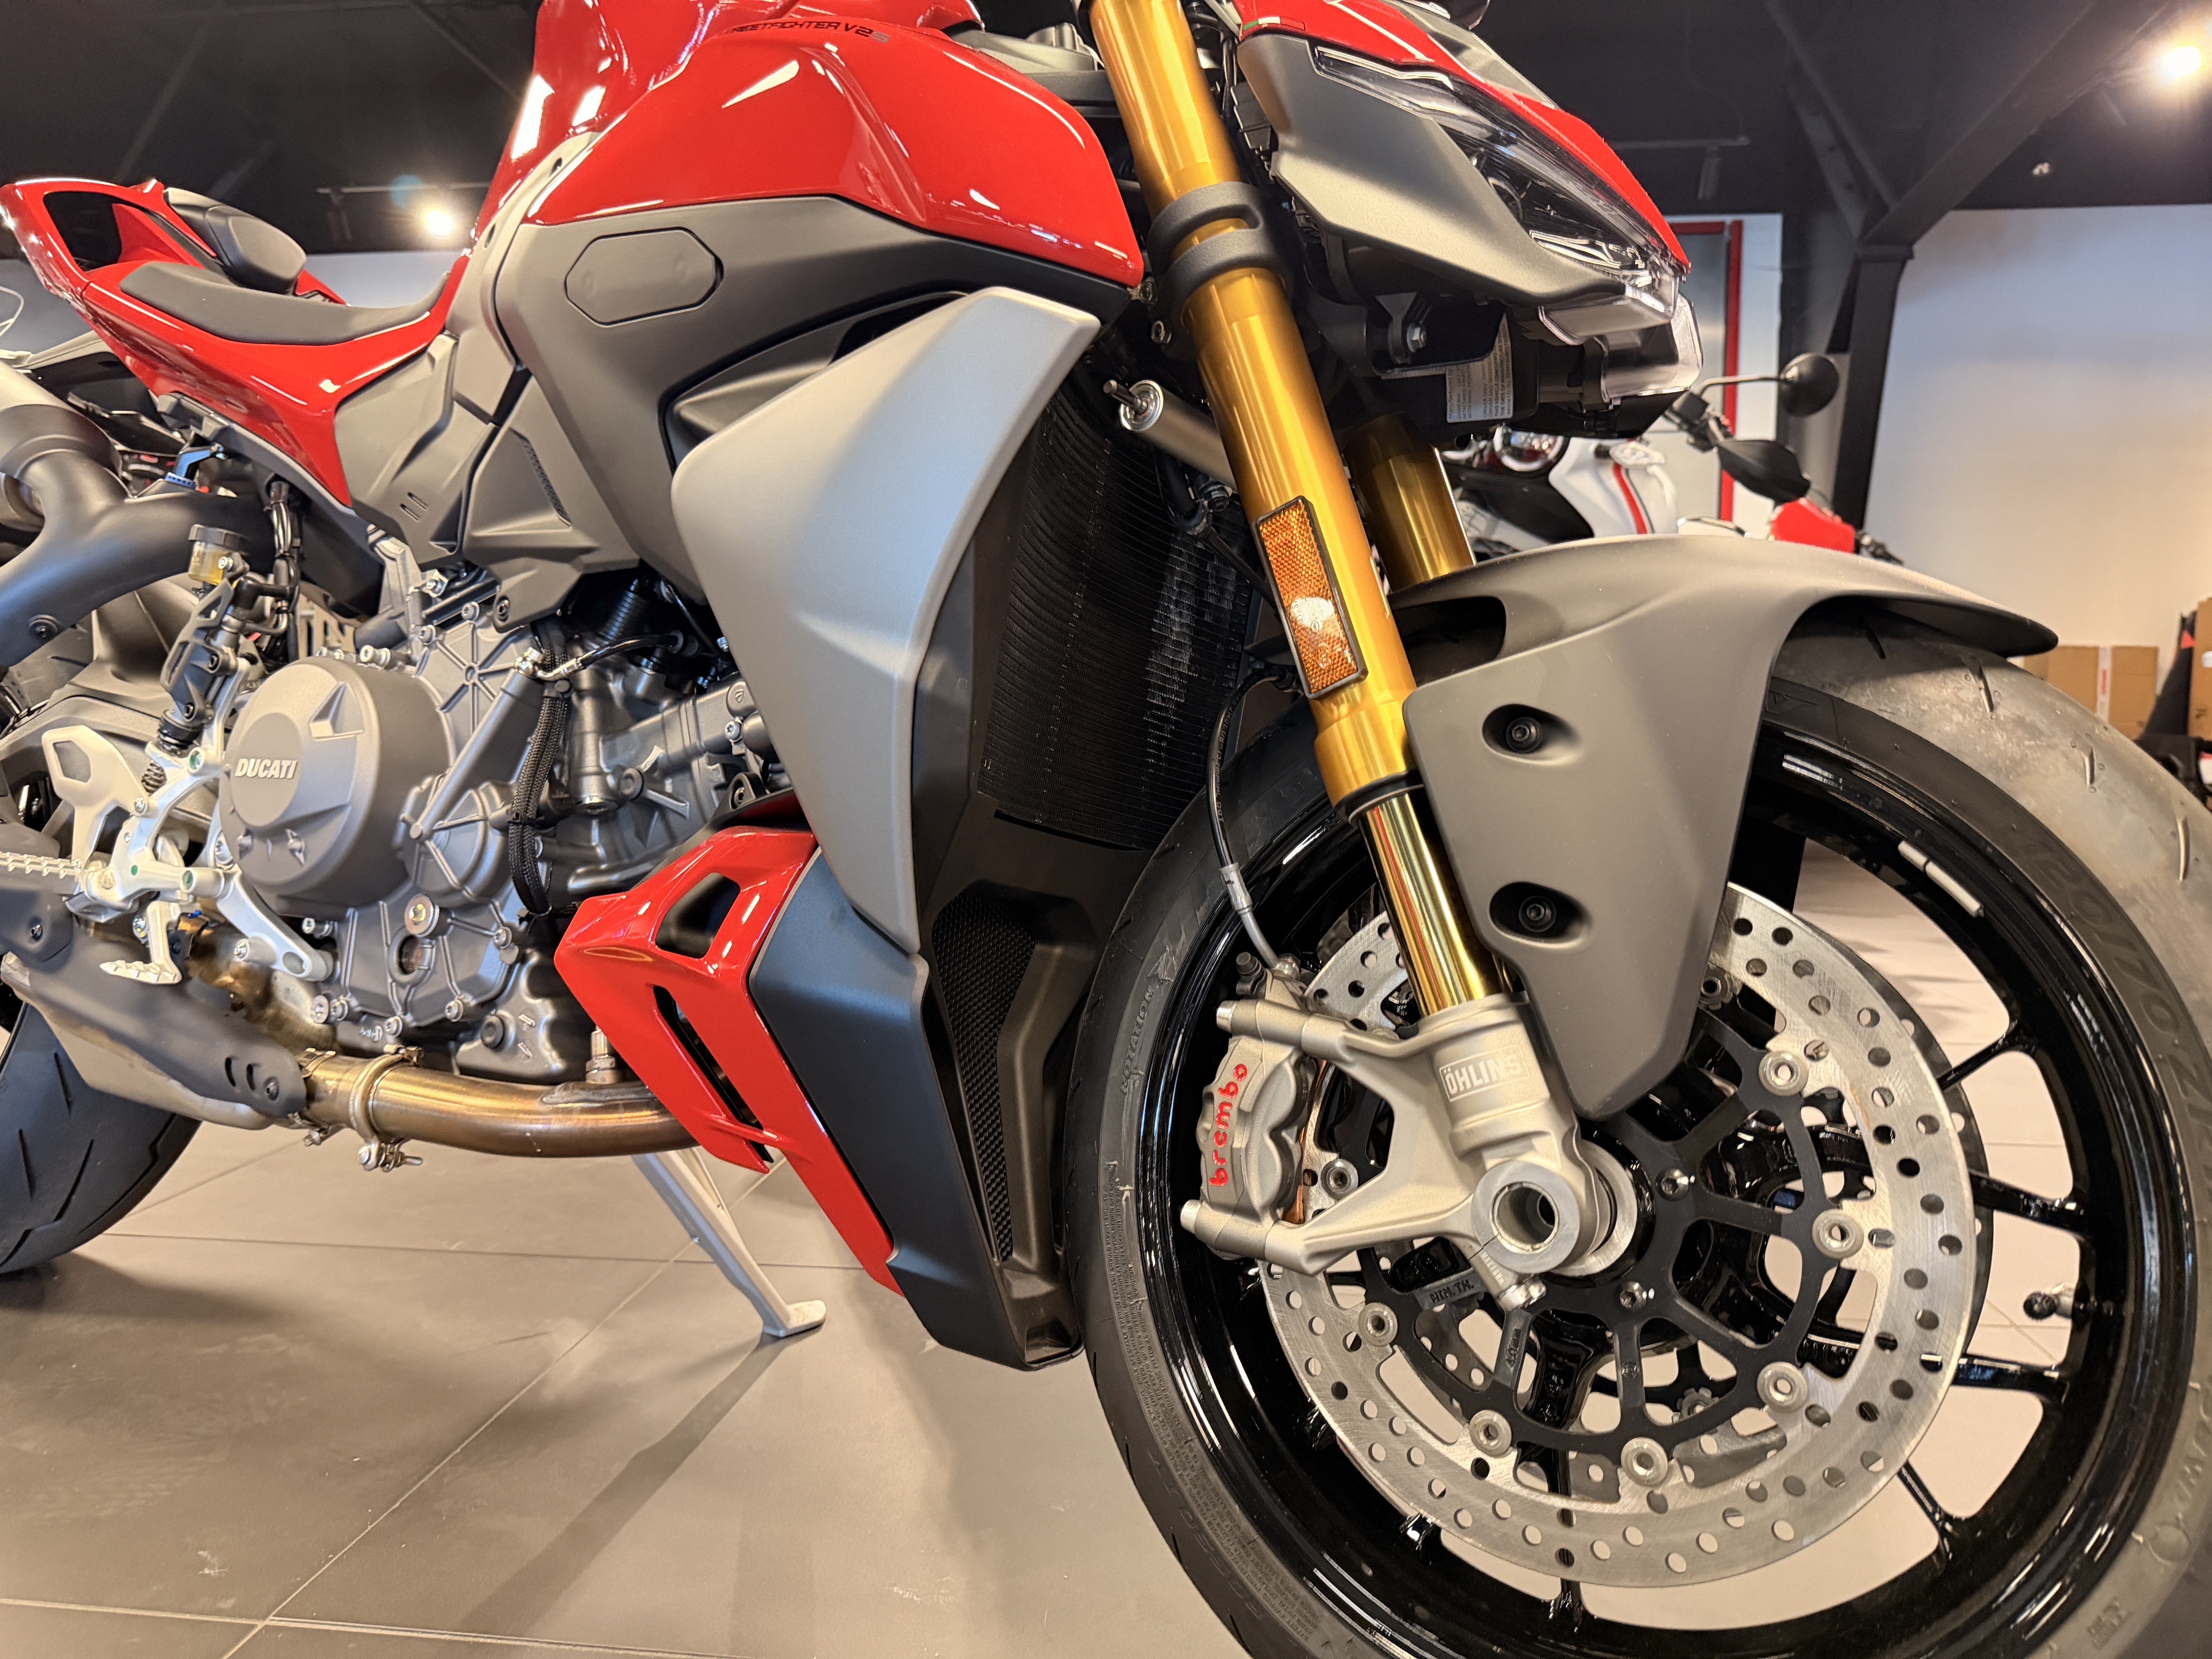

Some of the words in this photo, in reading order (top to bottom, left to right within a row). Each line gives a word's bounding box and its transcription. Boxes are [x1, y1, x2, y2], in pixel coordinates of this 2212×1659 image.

[235, 758, 298, 779] DUCATI
[1120, 983, 1154, 1095] ROTATION
[1444, 1054, 1522, 1094] ÖHLINS
[1209, 1063, 1248, 1187] brembo
